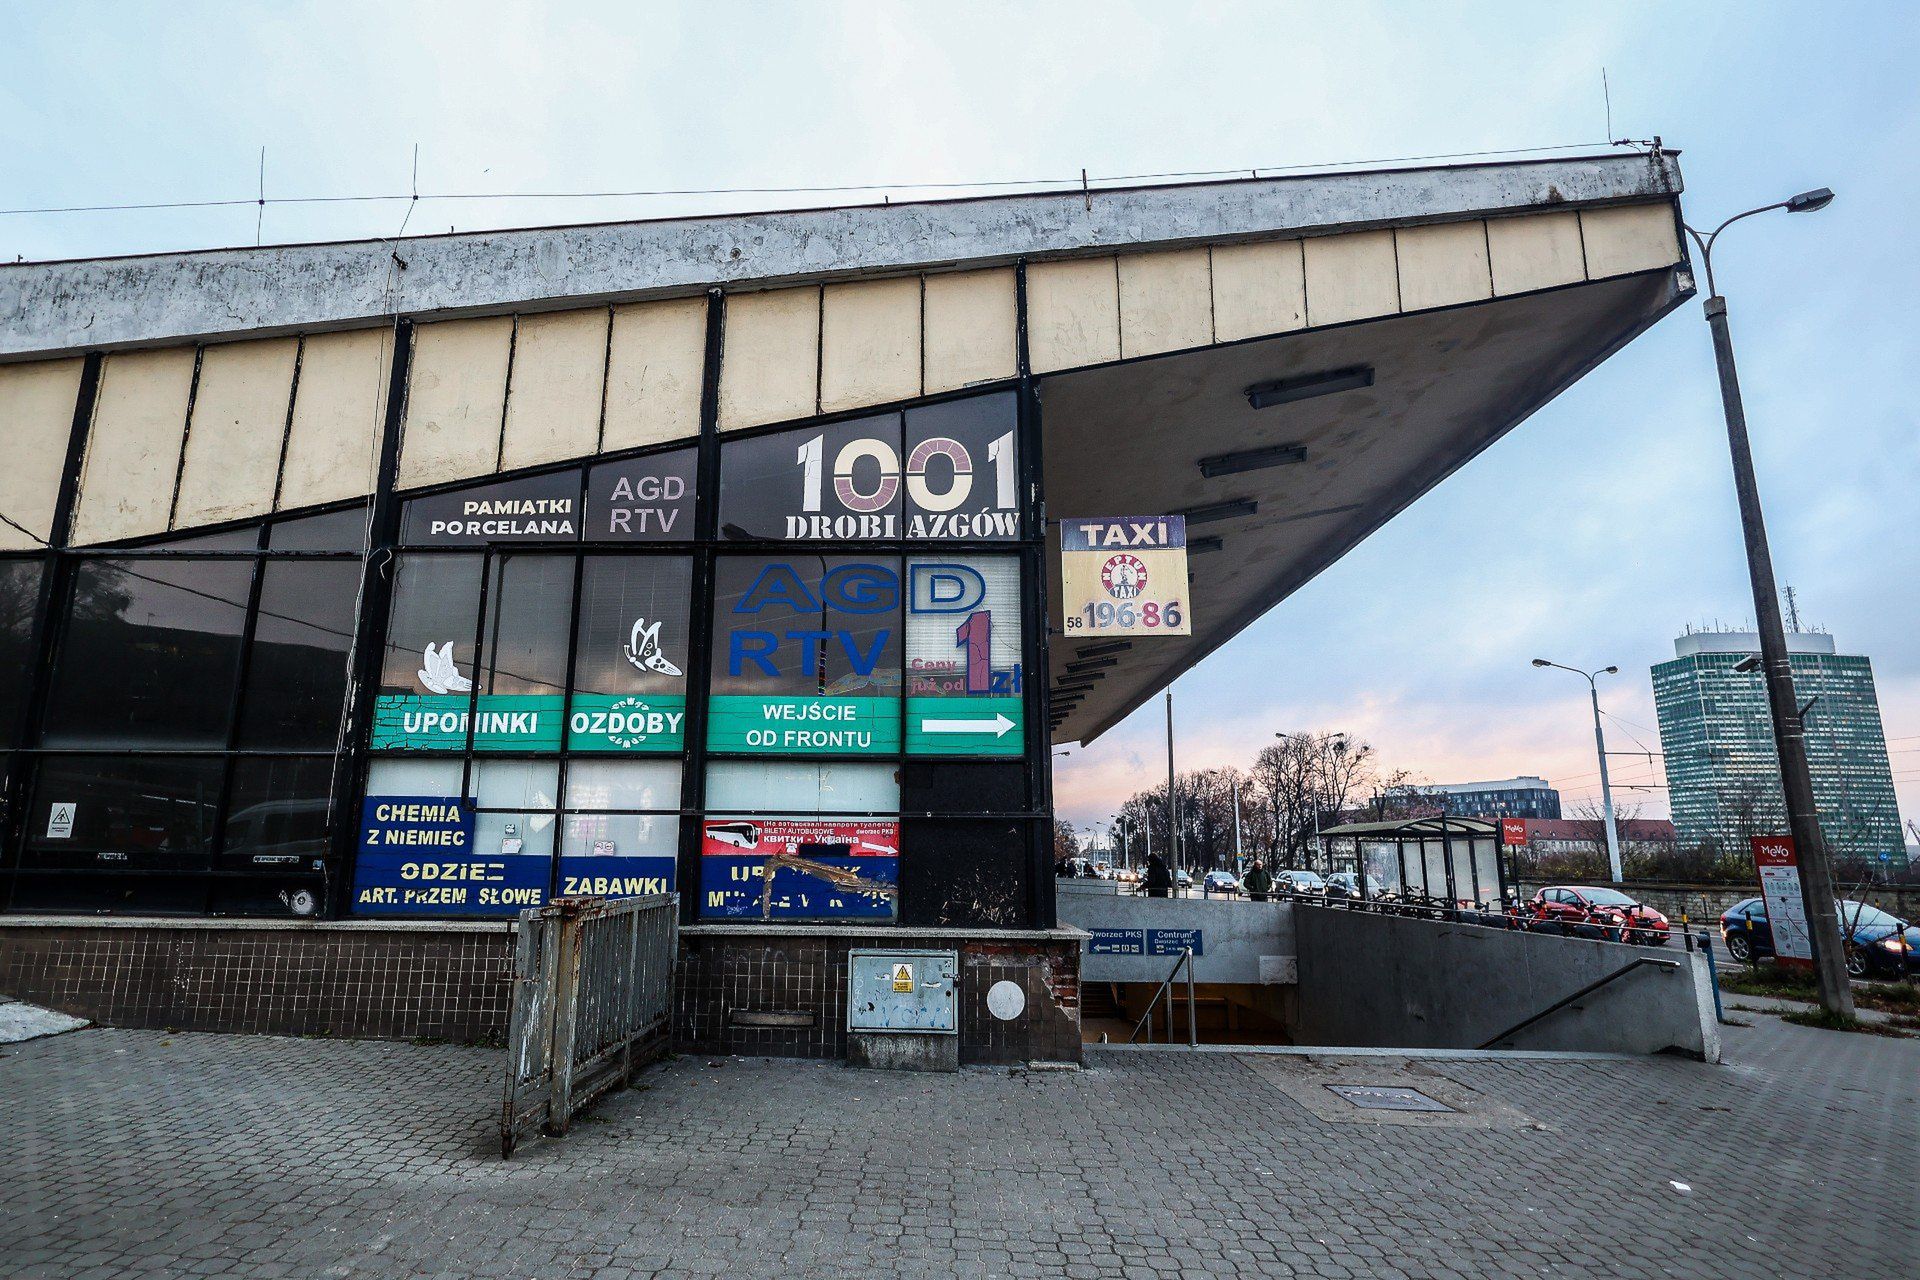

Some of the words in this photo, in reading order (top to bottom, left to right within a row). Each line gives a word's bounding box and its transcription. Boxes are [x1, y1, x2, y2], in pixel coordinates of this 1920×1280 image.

[797, 429, 1016, 513] 1001
[610, 476, 685, 501] AGD
[464, 499, 571, 516] PAMIĄTKI
[430, 520, 574, 535] PORCELANA
[609, 508, 679, 533] RTV
[1080, 521, 1168, 546] TAXI
[1102, 554, 1147, 581] NEPTUN
[732, 563, 987, 614] AGD
[1113, 585, 1137, 599] TAXI
[1067, 617, 1082, 628] 58
[729, 630, 890, 677] RTV
[943, 679, 964, 690] od
[956, 610, 991, 694] 1
[911, 658, 957, 675] Ceny
[763, 702, 856, 721] WEJŚCIE
[403, 712, 538, 734] UPOMINKI
[570, 712, 683, 734] OZDOBY
[746, 730, 776, 747] OD
[784, 731, 871, 748] FRONTU
[376, 804, 460, 823] CHEMIA
[367, 829, 380, 844] Z
[385, 830, 465, 846] NIEMIEC
[563, 877, 667, 895] ZABAWKI
[359, 888, 398, 903] ART.
[1125, 930, 1142, 938] PKS
[1158, 931, 1192, 939] Centrum
